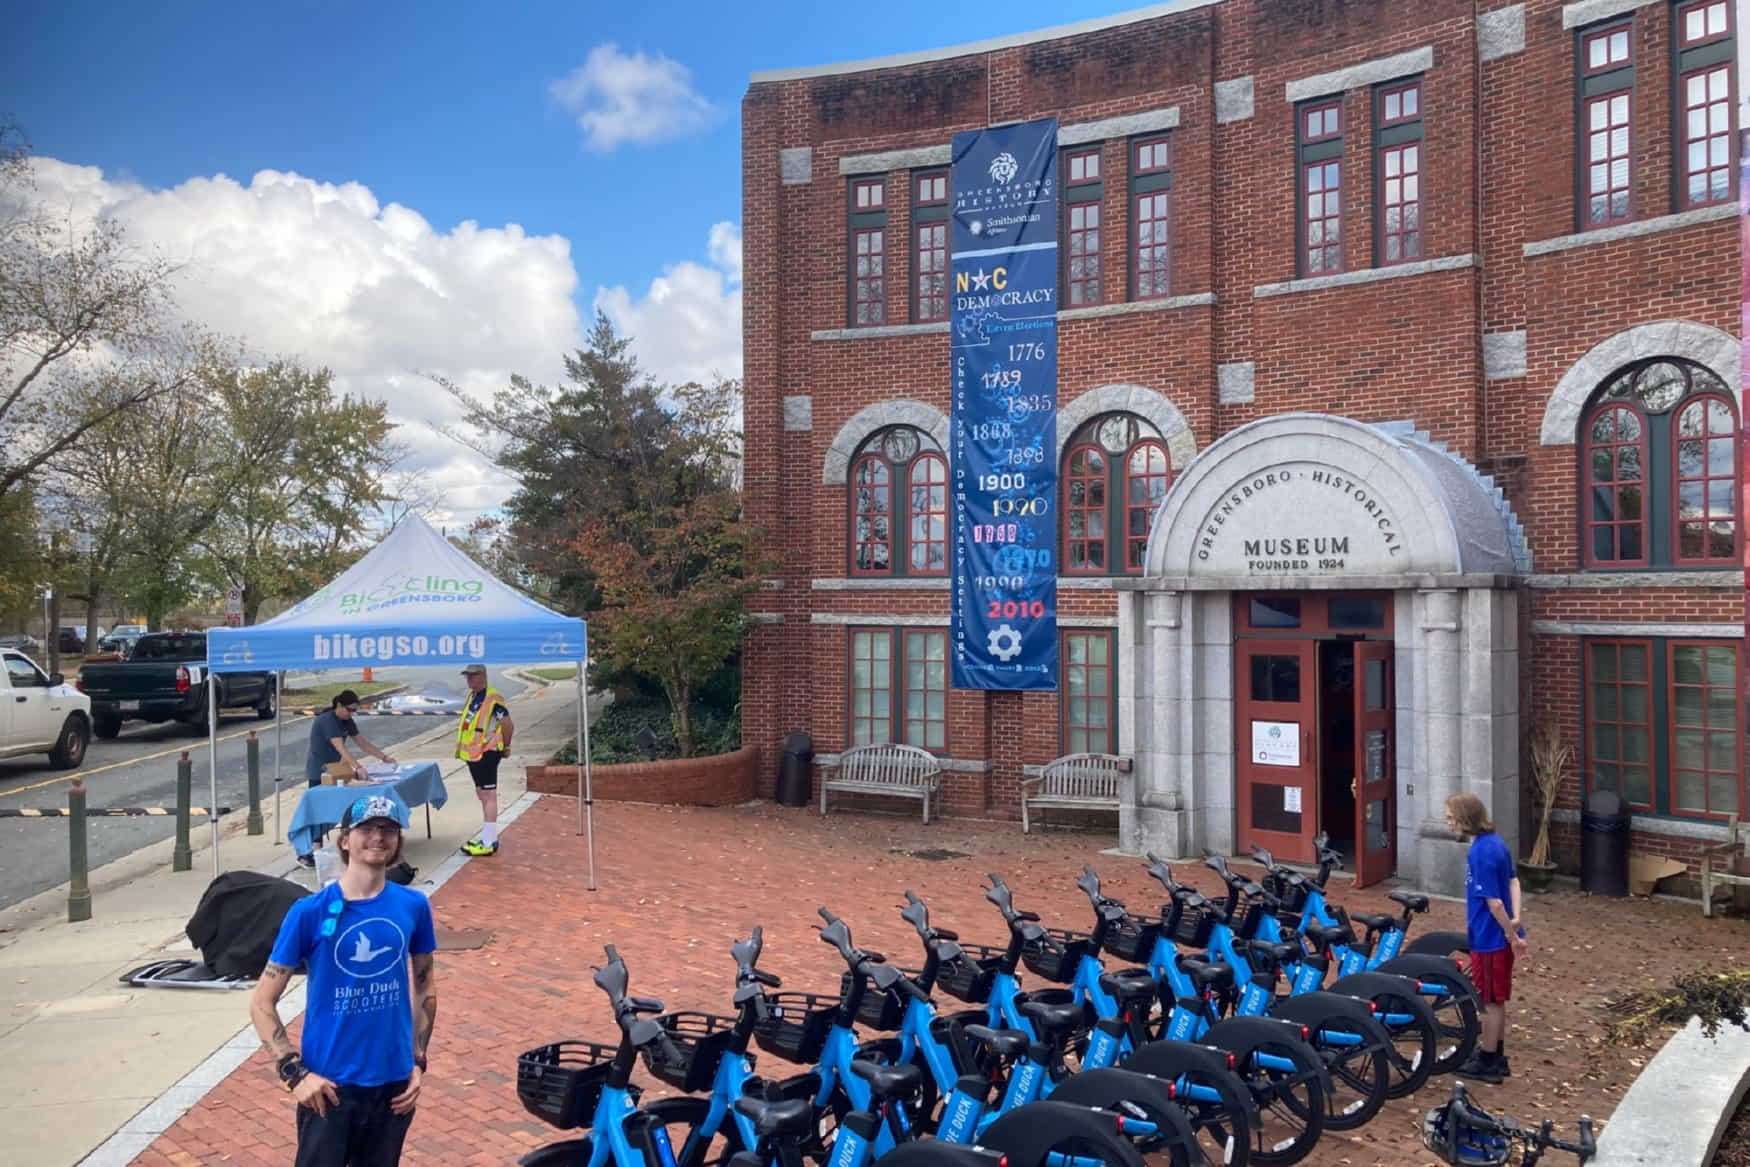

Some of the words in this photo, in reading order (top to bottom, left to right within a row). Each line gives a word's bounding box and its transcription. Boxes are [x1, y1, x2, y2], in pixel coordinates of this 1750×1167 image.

[957, 187, 1053, 208] HISTORY
[957, 287, 1054, 311] DEMOCRACY
[1008, 342, 1046, 362] 1776
[957, 356, 965, 410] Check
[981, 369, 1022, 389] 1789
[1007, 394, 1052, 413] 1835
[979, 472, 1025, 491] 1900
[956, 469, 966, 567] Democracy
[1197, 470, 1292, 561] GREENSBORO
[1311, 470, 1402, 558] HISTORICAL
[1243, 536, 1350, 557] MUSEUM
[1249, 560, 1309, 571] FOUNDED
[1318, 559, 1346, 570] 1924
[957, 575, 965, 661] Settings
[987, 601, 1045, 618] 2010
[313, 632, 485, 660] bikegso.org
[334, 985, 365, 999] Blue
[369, 977, 400, 995] Duck
[1018, 1064, 1035, 1093] DUCK
[951, 1096, 973, 1130] DUCK
